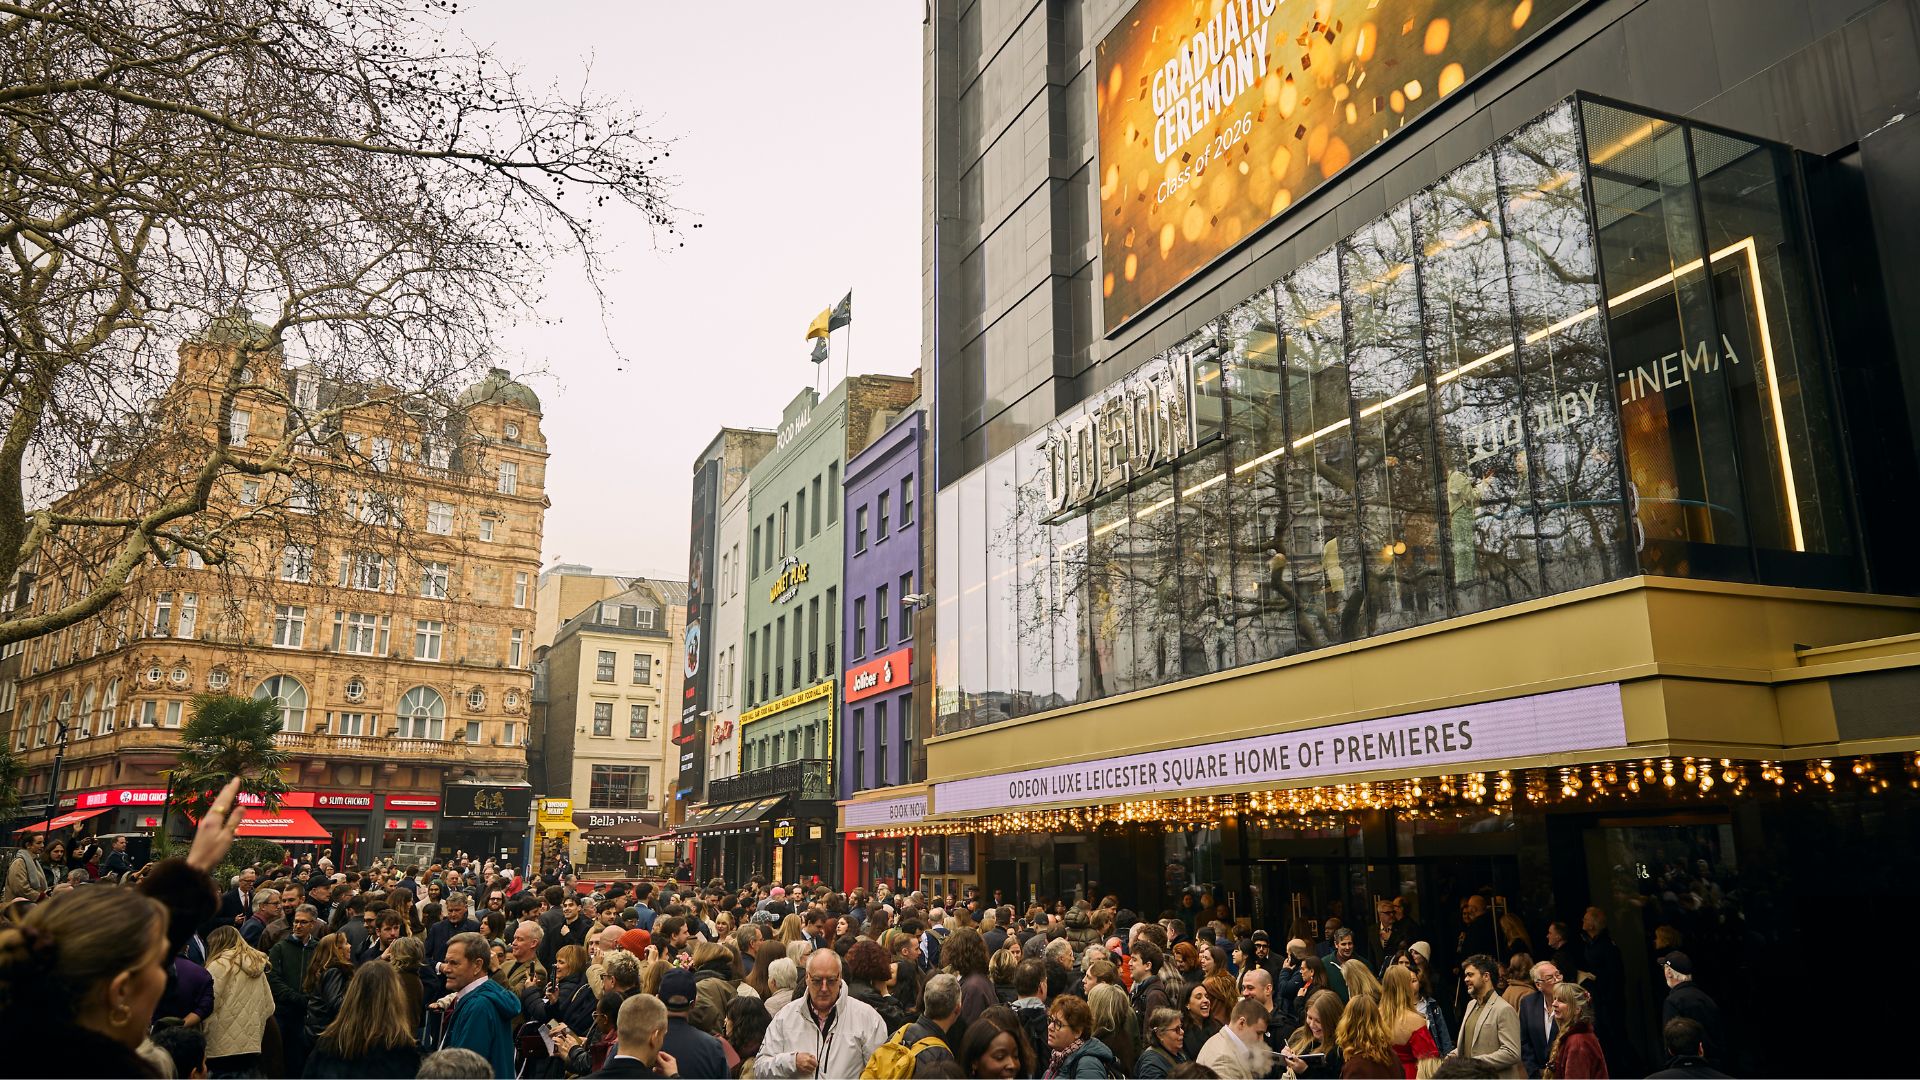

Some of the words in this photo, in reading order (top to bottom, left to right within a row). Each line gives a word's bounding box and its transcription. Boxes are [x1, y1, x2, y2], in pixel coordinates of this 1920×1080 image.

[1152, 0, 1286, 117] GRADUATI
[1153, 20, 1269, 164] CEREMONY
[1157, 165, 1190, 204] Class
[1195, 144, 1211, 174] of
[1213, 112, 1252, 160] 2026
[776, 422, 795, 454] FOOD
[795, 405, 811, 436] HALL
[1045, 350, 1198, 515] ODEON
[791, 562, 809, 585] PLACE
[804, 691, 813, 700] FOOD
[1009, 776, 1048, 799] ODEON
[1052, 772, 1082, 795] LUXE
[1086, 762, 1157, 791] LEICESTER
[1163, 752, 1227, 786] SQUARE
[1235, 745, 1291, 775] HOME
[1298, 740, 1324, 768] OF
[1333, 720, 1473, 765] PREMIERES
[149, 792, 171, 801] CHICK
[329, 796, 344, 805] SLIM
[344, 796, 370, 806] CHICKENS
[889, 803, 908, 819] BOOK
[910, 801, 927, 816] NOW
[589, 815, 615, 827] Bella
